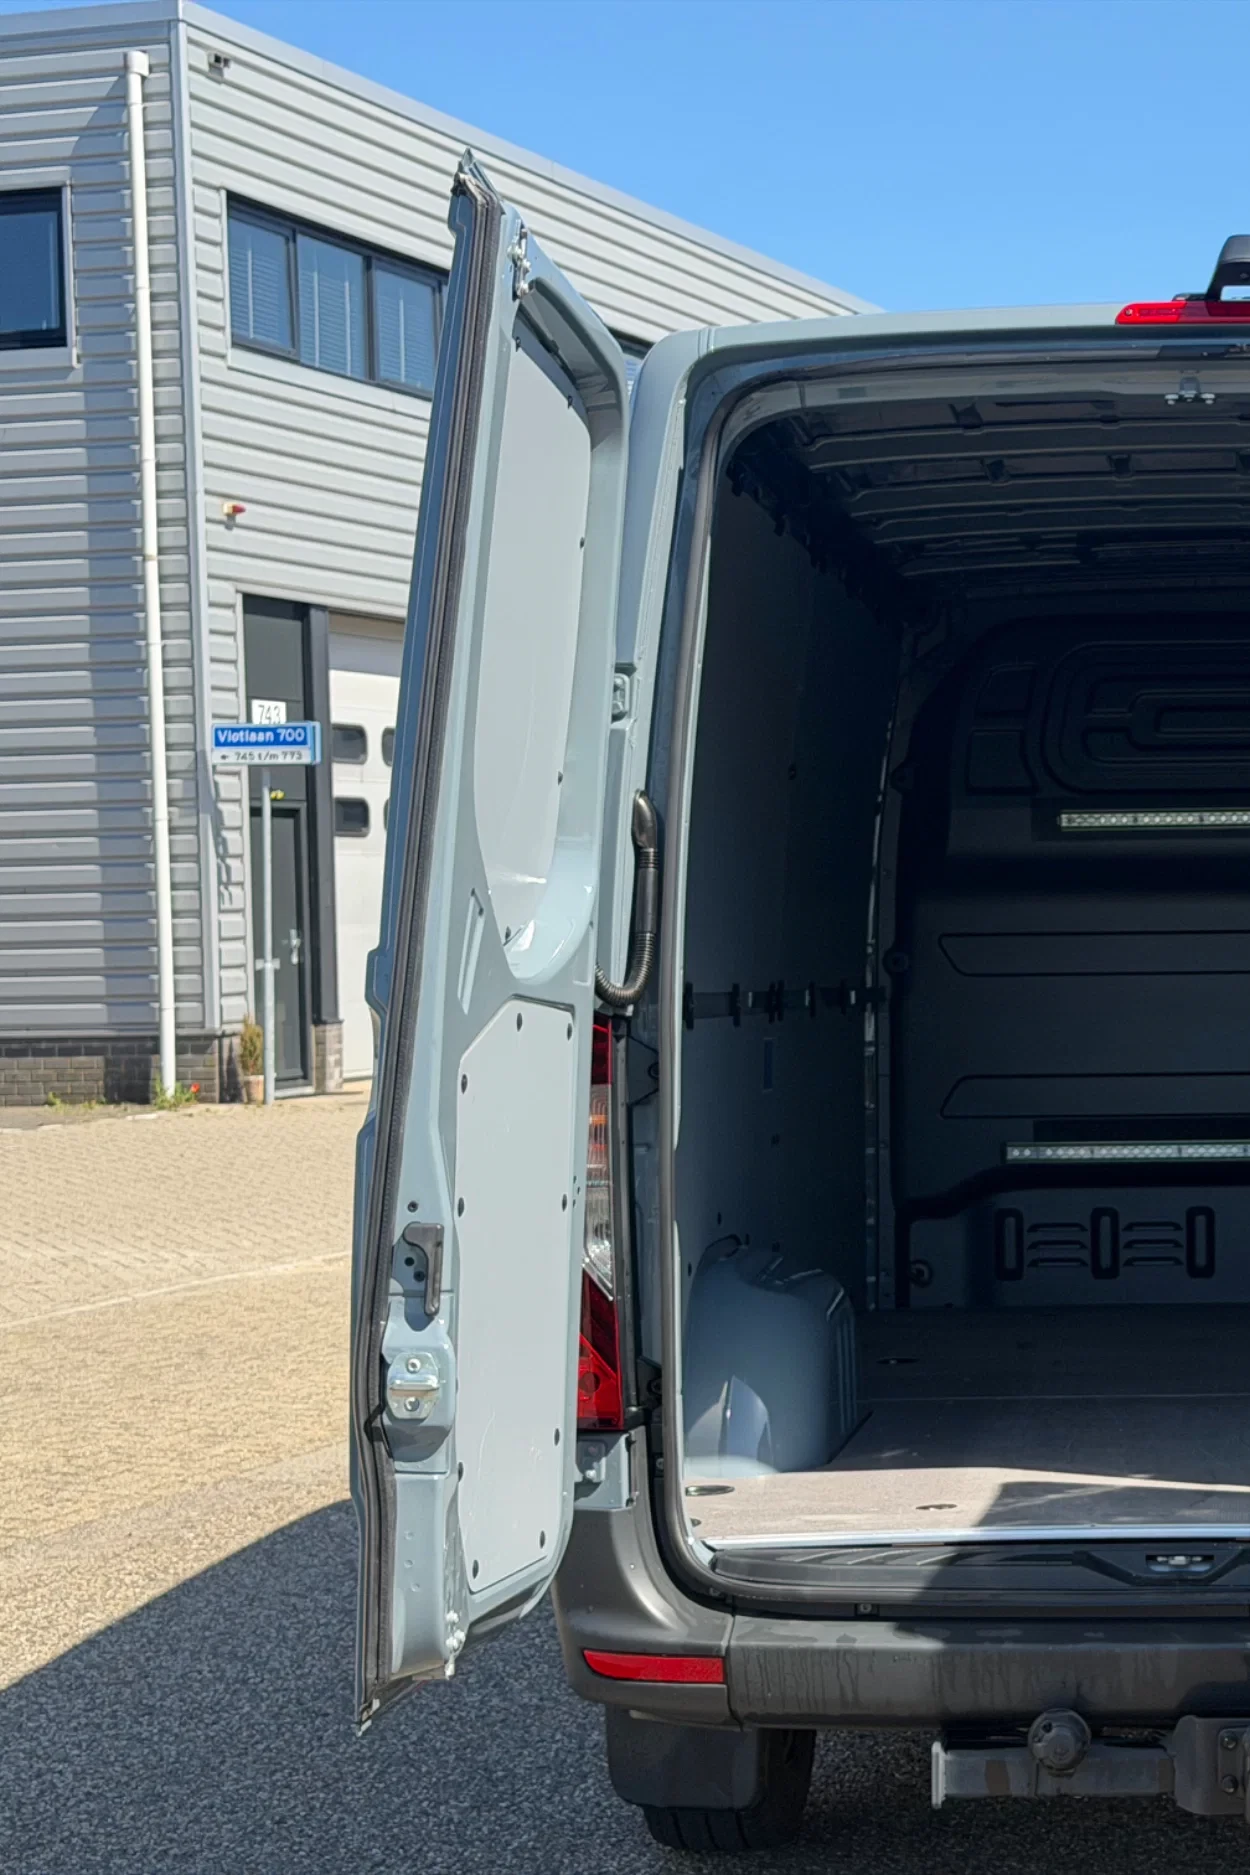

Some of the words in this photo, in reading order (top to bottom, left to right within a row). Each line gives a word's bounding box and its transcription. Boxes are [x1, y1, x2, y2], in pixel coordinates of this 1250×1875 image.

[258, 704, 281, 724] 743
[217, 729, 274, 743] Vlotlaan
[276, 728, 305, 741] 700
[234, 751, 255, 760] 745
[258, 750, 279, 760] t/m
